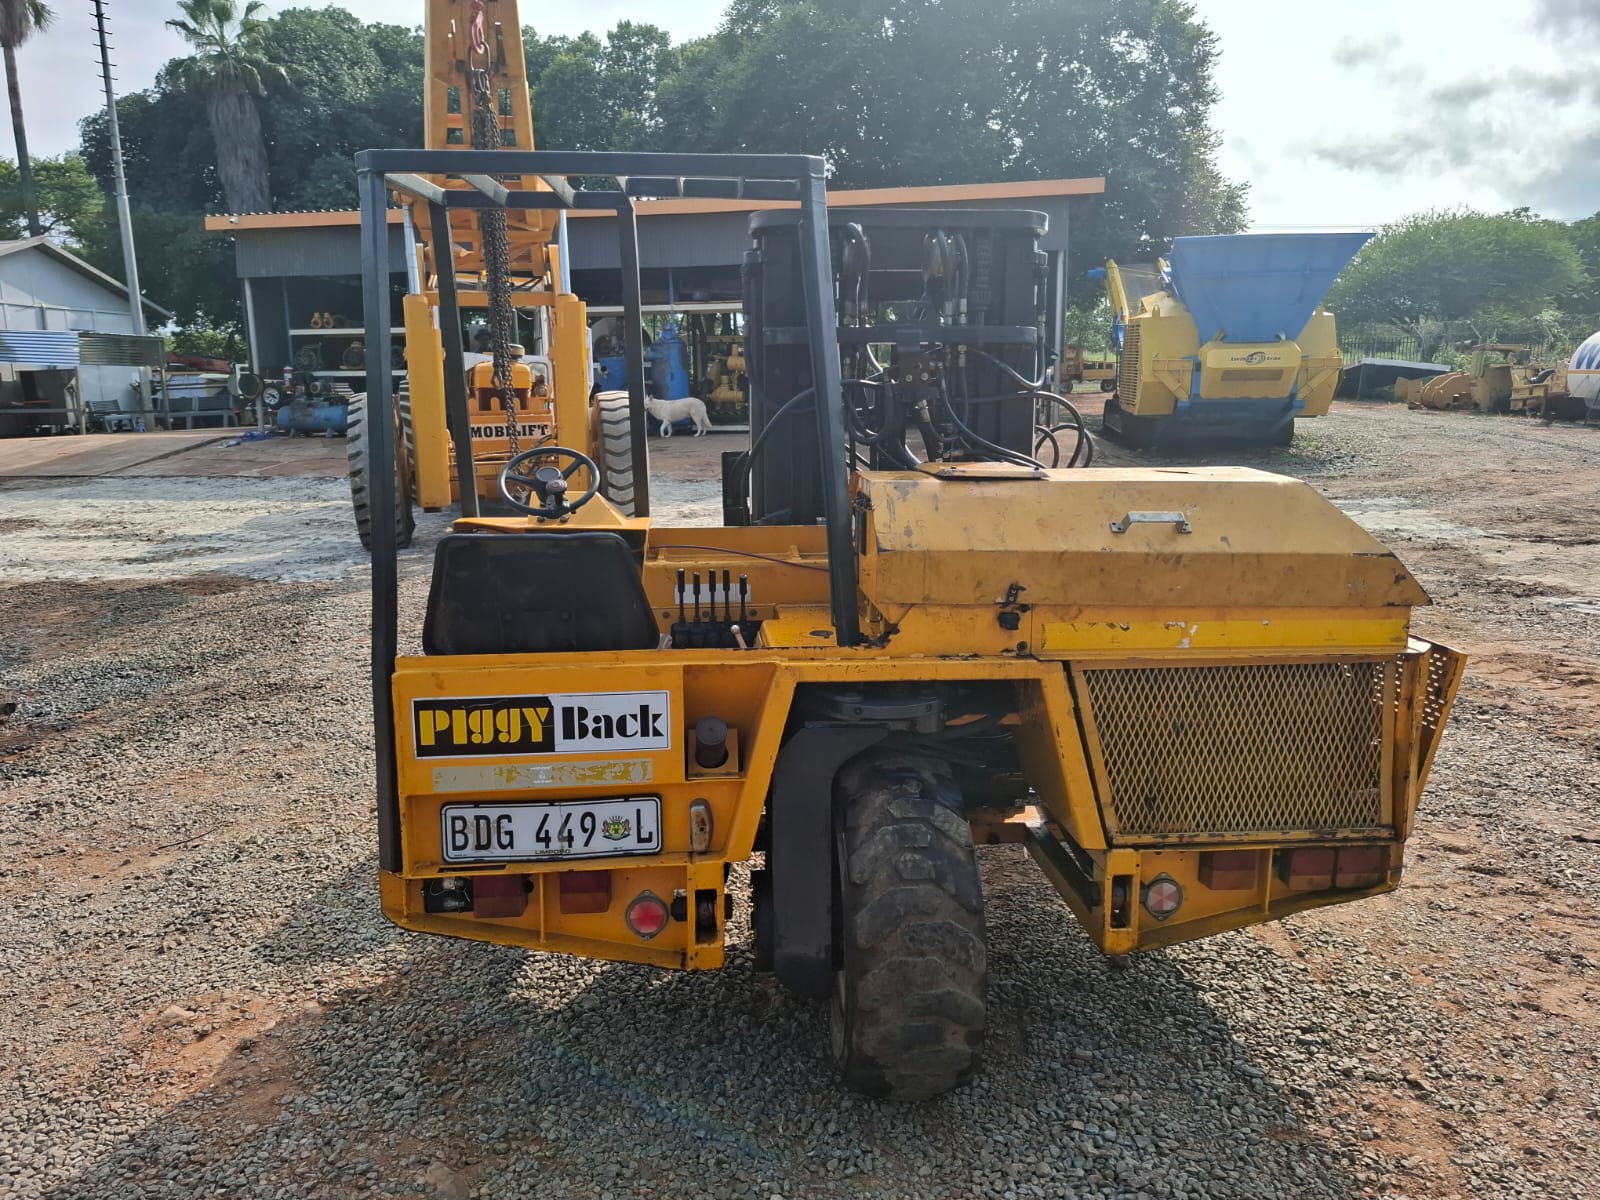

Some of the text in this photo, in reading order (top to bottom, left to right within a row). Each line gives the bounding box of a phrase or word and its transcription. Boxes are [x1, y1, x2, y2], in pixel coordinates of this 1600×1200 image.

[562, 704, 665, 740] Back
[450, 807, 654, 852] BDG 449 L
